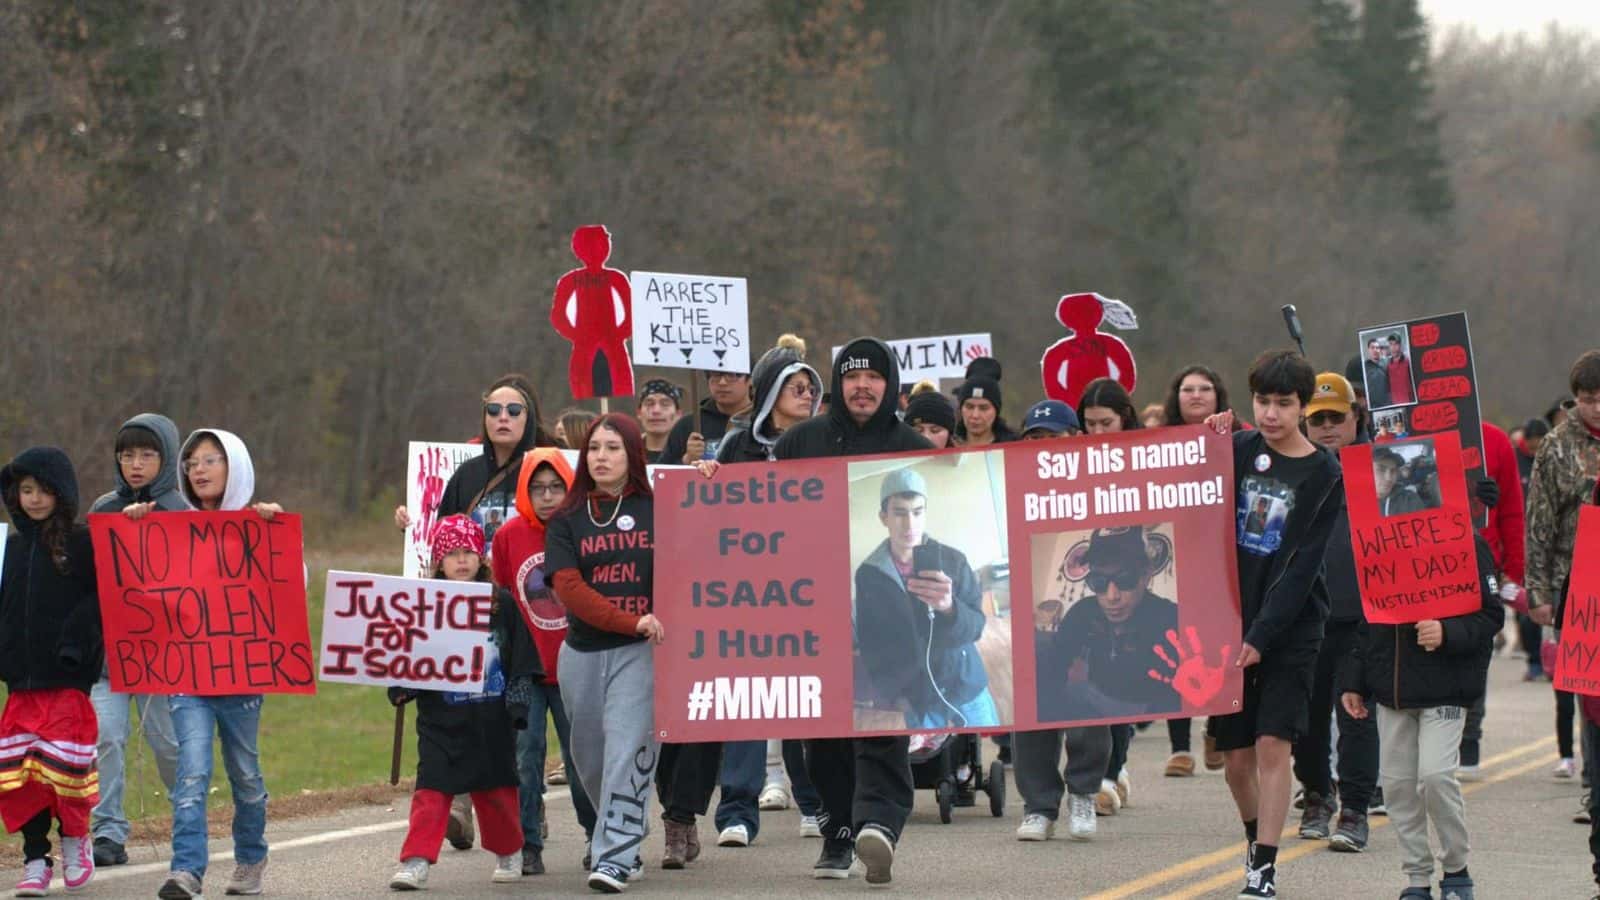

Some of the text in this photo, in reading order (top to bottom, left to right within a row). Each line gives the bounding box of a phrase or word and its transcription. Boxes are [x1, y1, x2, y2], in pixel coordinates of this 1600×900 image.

[646, 278, 733, 305] ARREST
[662, 306, 711, 326] THE
[650, 322, 740, 348] KILLERS
[1037, 436, 1207, 481] Say his name!
[680, 471, 825, 509] Justice
[1024, 489, 1088, 521] Bring
[1094, 483, 1141, 515] him
[1146, 476, 1224, 510] home!
[108, 519, 289, 587] NO MORE
[580, 530, 655, 557] NATIVE.
[718, 527, 785, 556] For
[1356, 513, 1466, 558] WHERE'S
[592, 562, 640, 583] MEN.
[1363, 551, 1469, 590] MY DAD?
[691, 578, 815, 608] ISAAC
[122, 584, 276, 639] STOLEN
[364, 621, 429, 654] For
[688, 629, 820, 659] J Hunt
[116, 638, 314, 690] BROTHERS
[322, 645, 485, 683] Isaac!
[1562, 640, 1599, 672] MY
[686, 675, 822, 721] #MMIR
